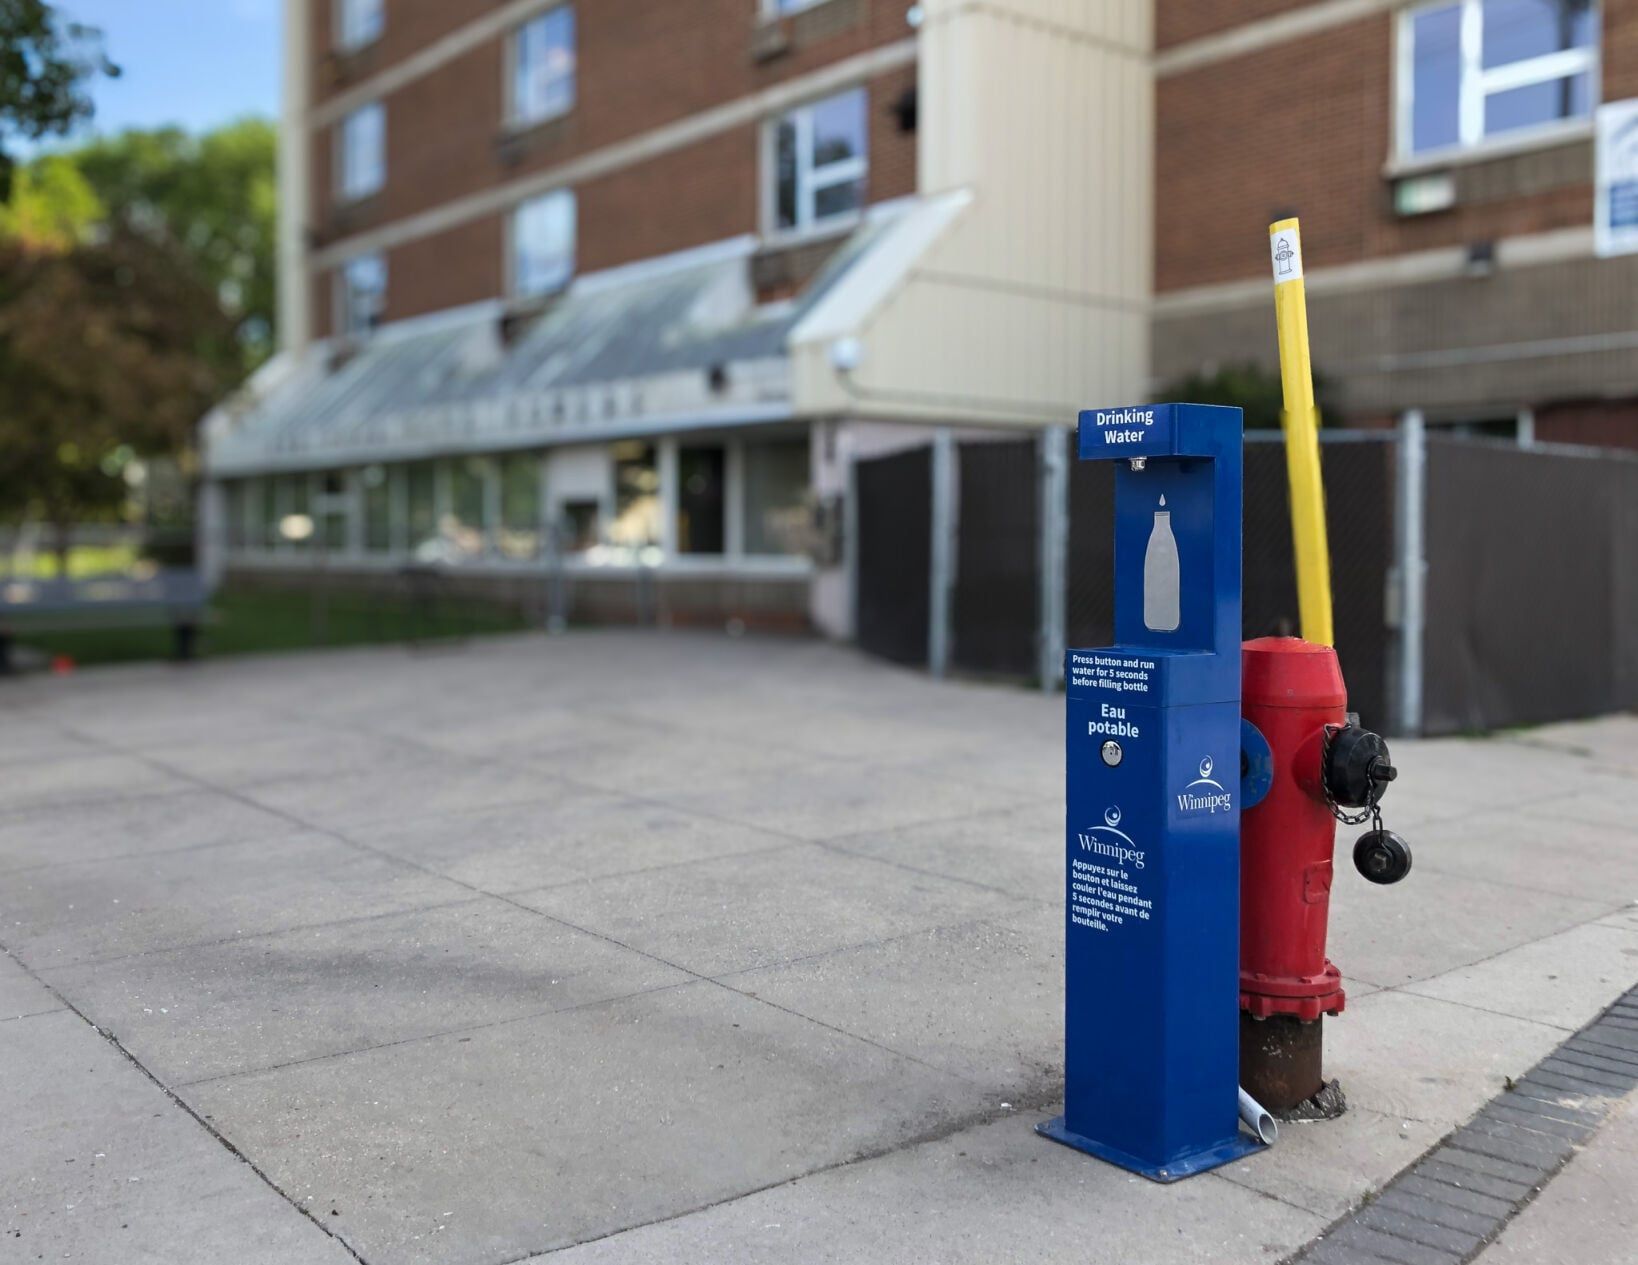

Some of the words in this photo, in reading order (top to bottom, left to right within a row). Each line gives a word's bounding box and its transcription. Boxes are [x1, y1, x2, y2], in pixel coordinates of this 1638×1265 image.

[1097, 409, 1153, 425] Drinking
[1105, 430, 1144, 443] Water
[1073, 655, 1093, 664] Press
[1095, 656, 1121, 666] button
[1123, 660, 1138, 668] and
[1073, 667, 1094, 675] water
[1097, 668, 1107, 677] for
[1116, 670, 1148, 680] seconds
[1073, 677, 1097, 686] before
[1099, 679, 1121, 691] filling
[1123, 681, 1148, 692] bottle
[1101, 704, 1125, 719] Eau
[1088, 721, 1139, 737] potable
[1178, 793, 1231, 813] Winnipeg
[1079, 834, 1144, 869] Winnipeg
[1073, 859, 1105, 874] Appuyez
[1106, 868, 1119, 877] sur
[1121, 870, 1128, 880] le
[1073, 870, 1100, 884] bouton
[1102, 878, 1109, 886] et
[1111, 880, 1137, 893] laissez
[1073, 882, 1095, 894] couler
[1098, 886, 1116, 900] l'eau
[1118, 893, 1152, 909] pendant
[1073, 905, 1101, 919] remplir
[1102, 911, 1123, 924] votre
[1079, 896, 1113, 910] secondes
[1115, 905, 1138, 917] avant
[1140, 910, 1150, 919] de
[1073, 914, 1108, 931] bouteille.
